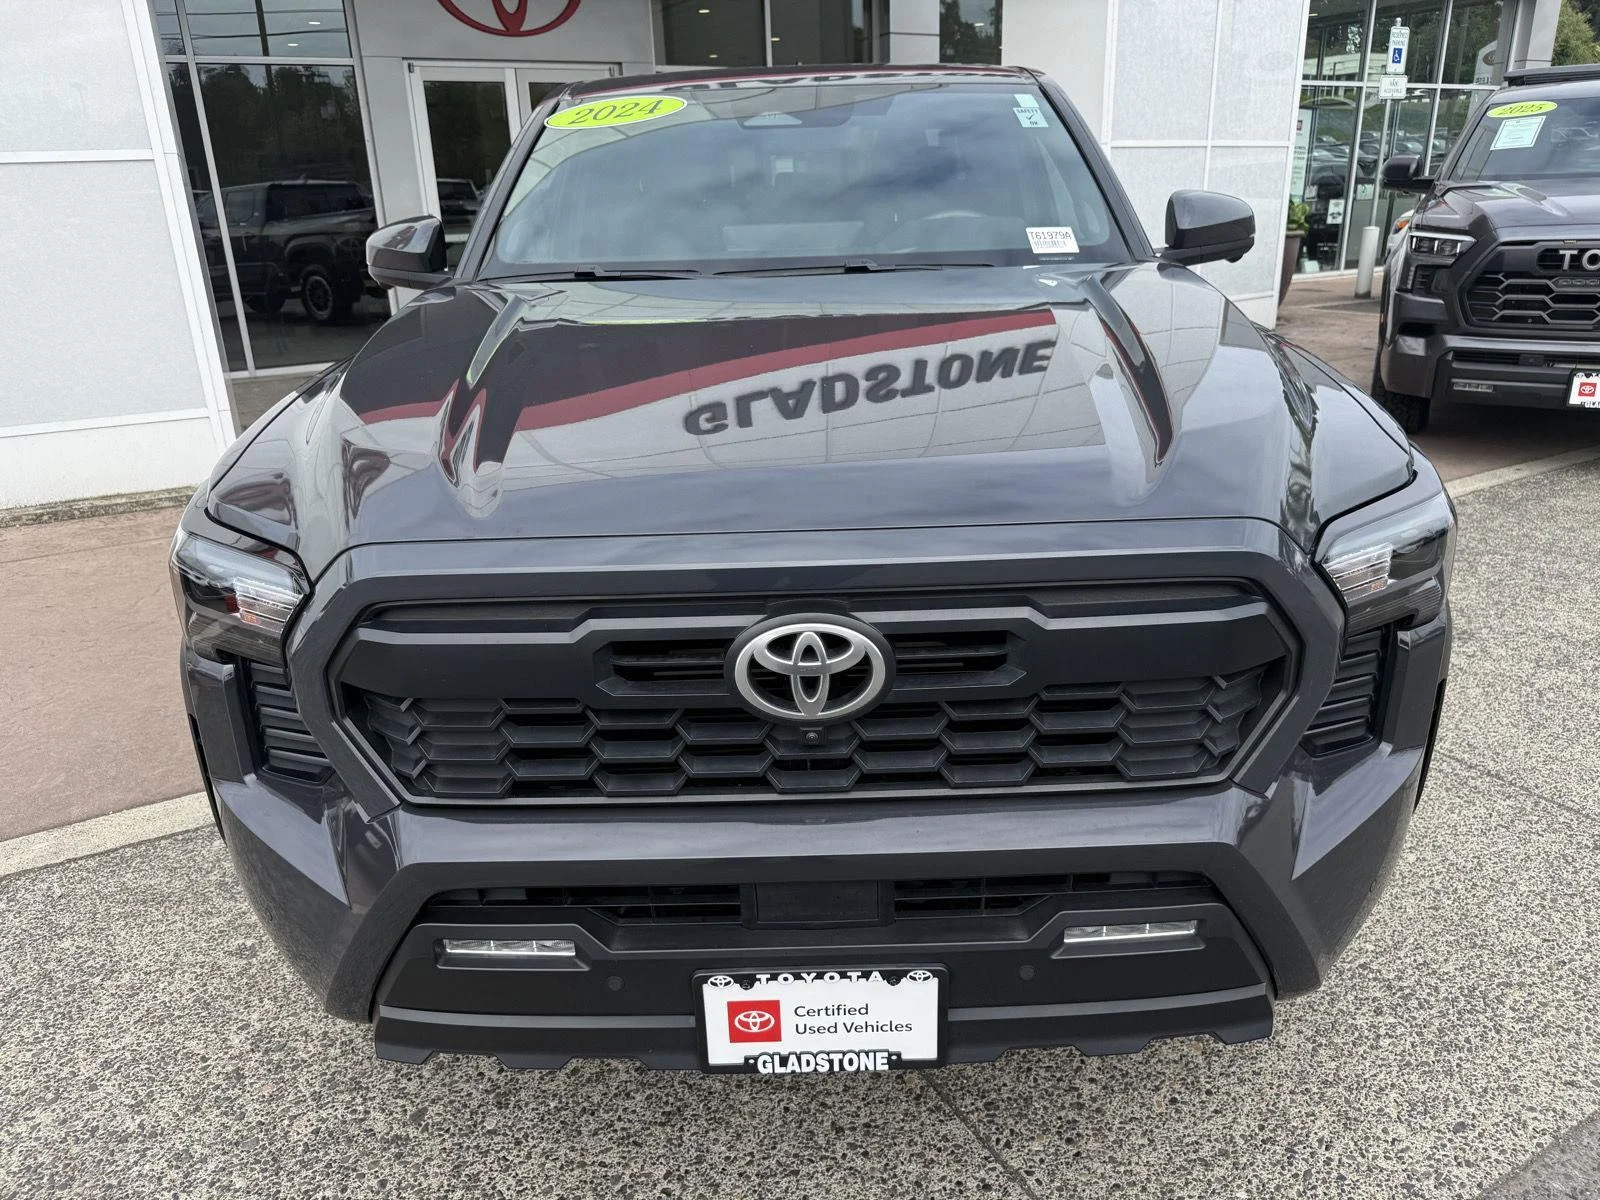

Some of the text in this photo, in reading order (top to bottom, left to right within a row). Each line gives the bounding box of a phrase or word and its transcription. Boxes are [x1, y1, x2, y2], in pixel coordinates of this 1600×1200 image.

[568, 99, 664, 125] 2024
[1498, 103, 1547, 116] 2025
[1028, 231, 1072, 241] T61979A
[756, 970, 886, 985] TOYOTA
[794, 1003, 869, 1018] Certified
[795, 1020, 913, 1035] Used Vehicles
[757, 1050, 890, 1074] GLADSTONE
